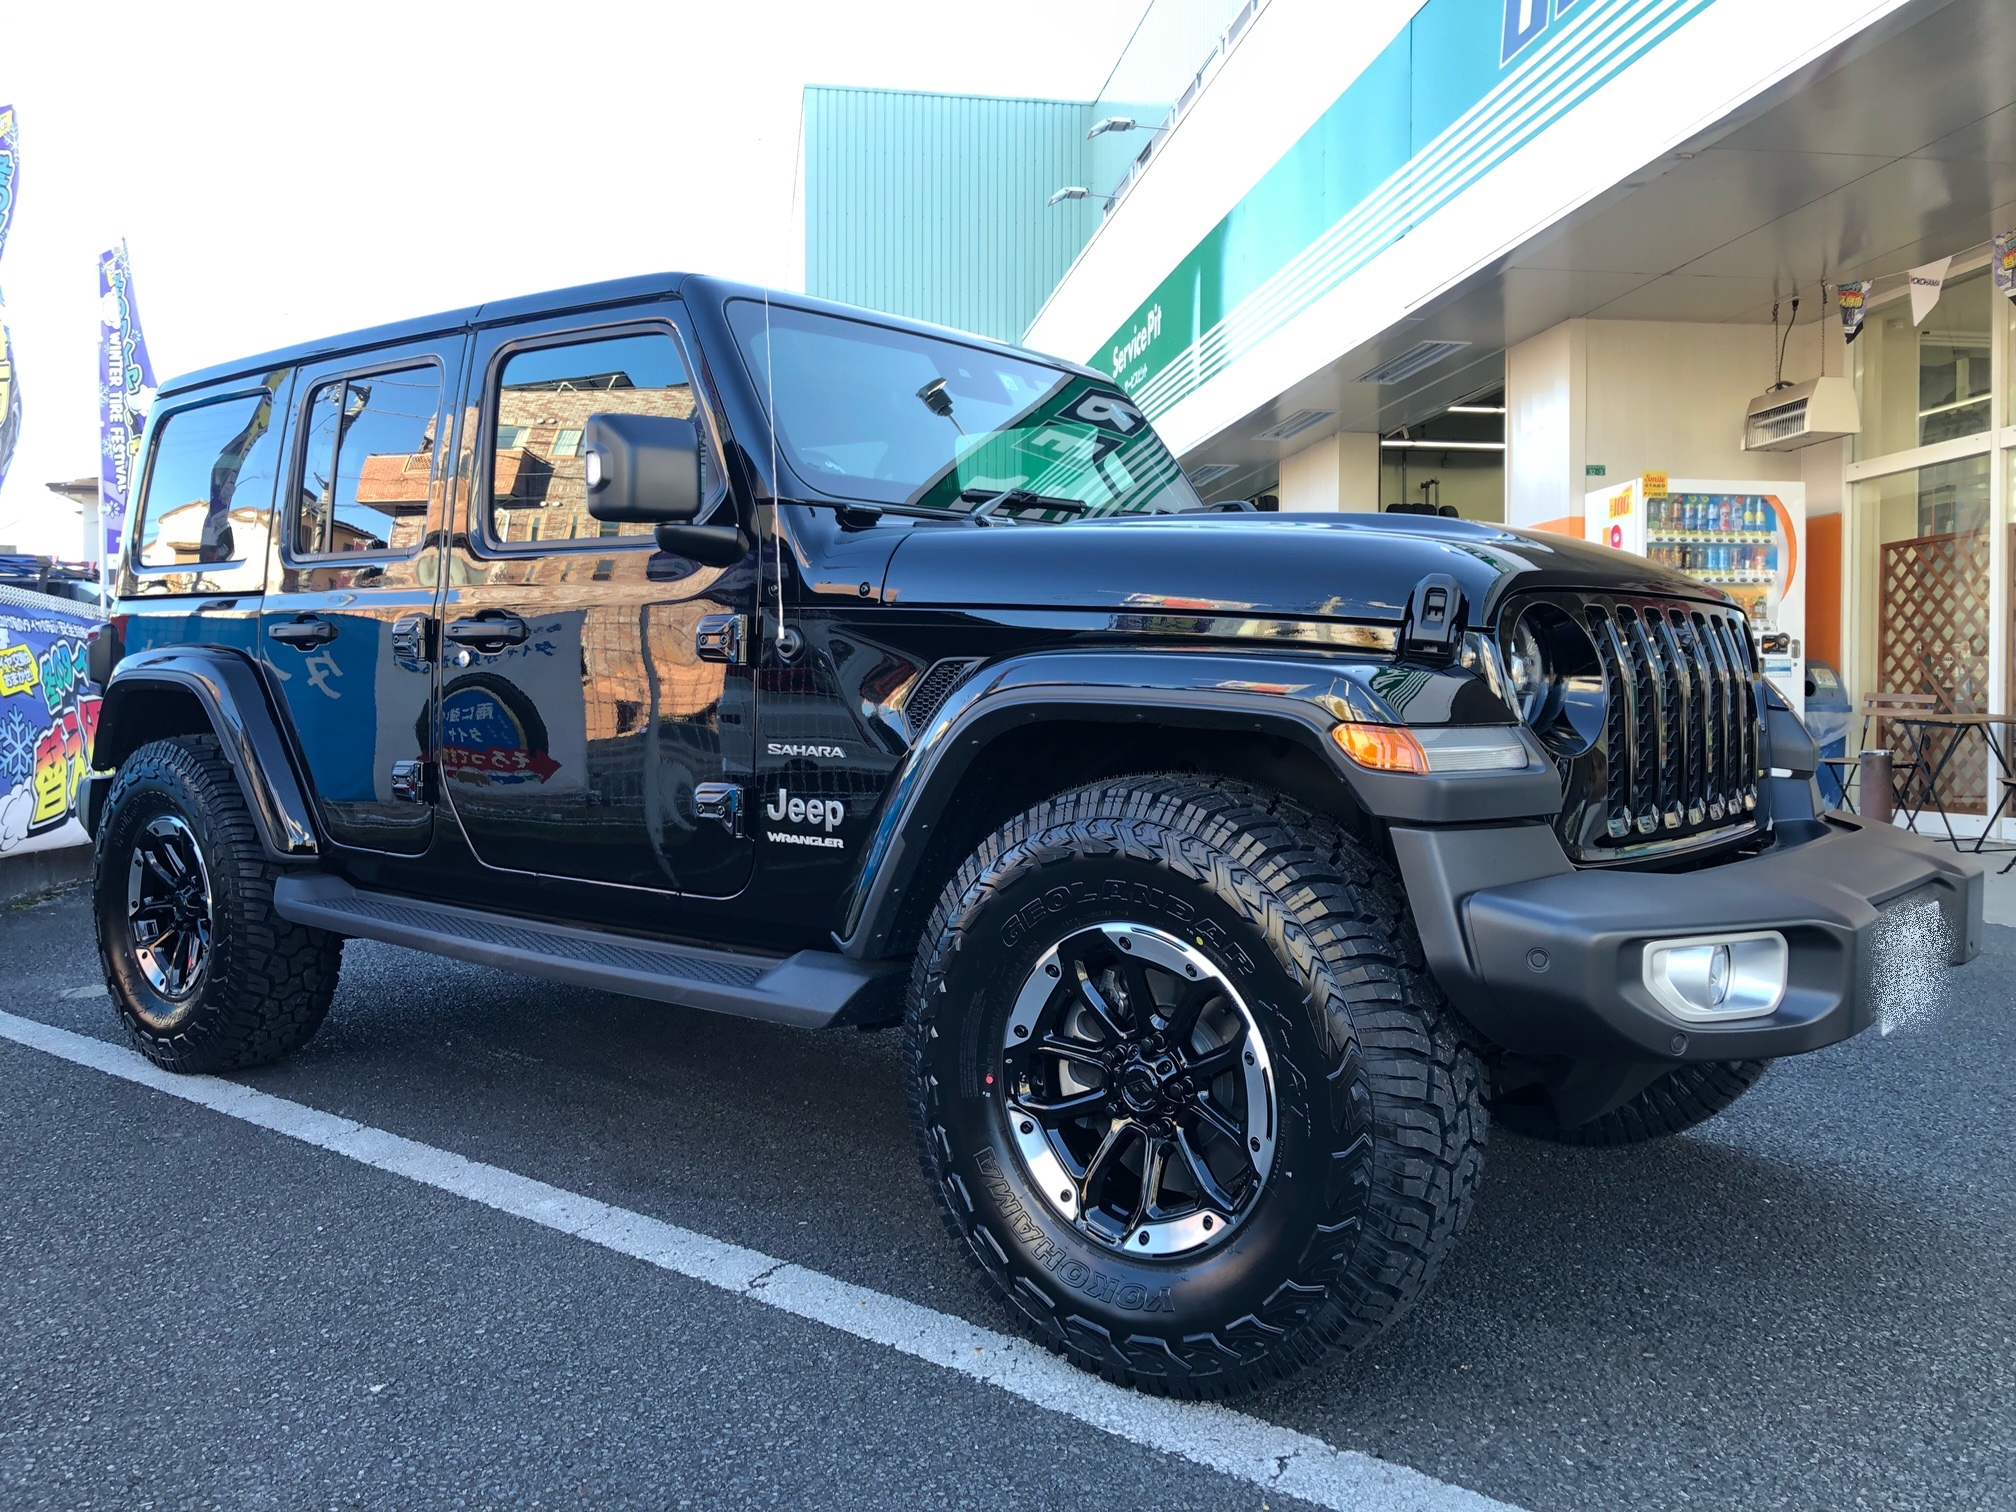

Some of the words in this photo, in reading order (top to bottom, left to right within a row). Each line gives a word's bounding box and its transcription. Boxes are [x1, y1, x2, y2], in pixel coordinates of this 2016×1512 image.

[1910, 277, 1941, 287] YOKOHAMA
[108, 331, 123, 387] WINTER
[108, 390, 124, 424] TIRE
[110, 427, 127, 494] FESTIVAL
[1644, 473, 1666, 483] Smile
[767, 743, 846, 758] SAHARA
[767, 788, 844, 832] Jeep
[767, 831, 844, 848] WRANGLER
[1002, 879, 1257, 977] GEOLANDAR
[974, 1146, 1178, 1313] YOKOHAMA
